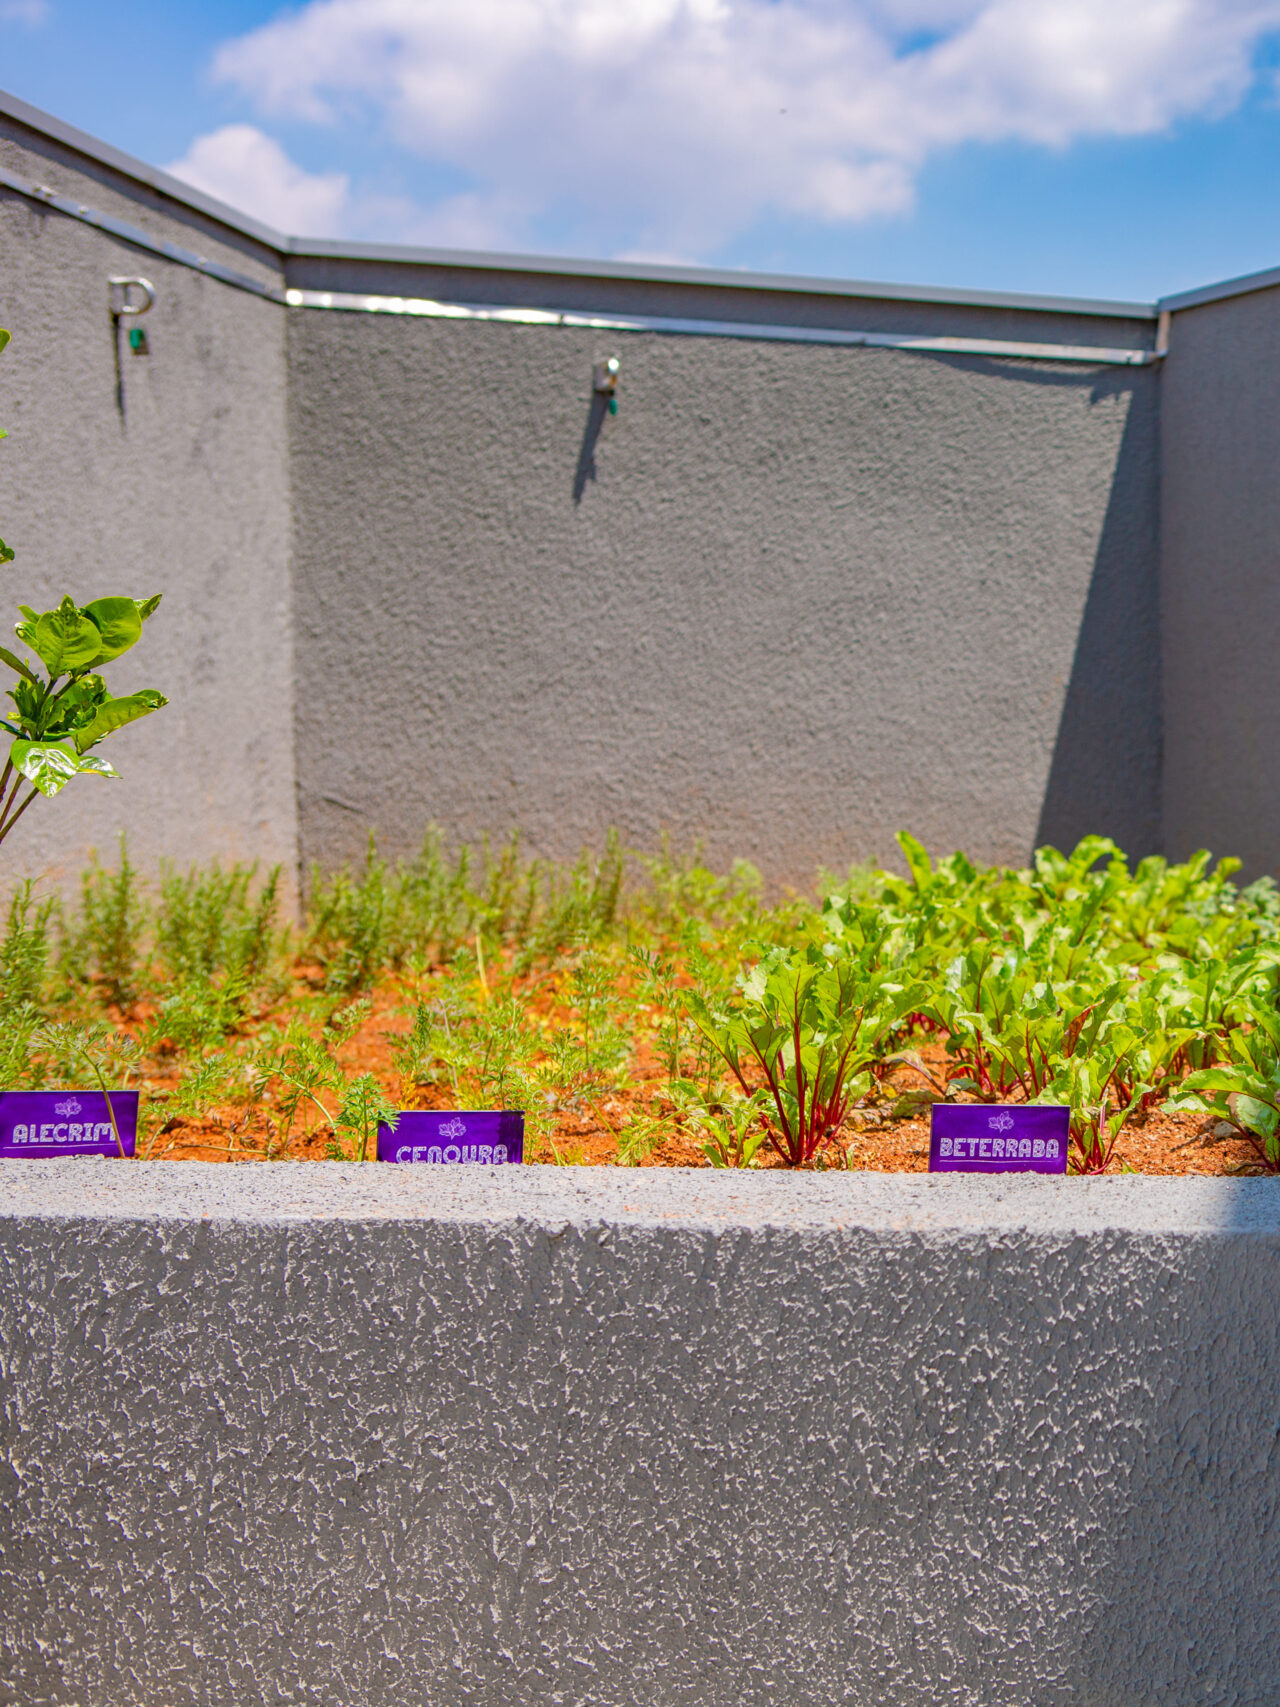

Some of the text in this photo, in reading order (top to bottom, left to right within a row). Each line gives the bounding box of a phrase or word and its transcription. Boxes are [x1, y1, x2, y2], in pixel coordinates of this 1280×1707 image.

[12, 1122, 117, 1143] ALECRIM
[395, 1144, 508, 1164] CENOURA
[939, 1137, 1060, 1158] BETERRABA
